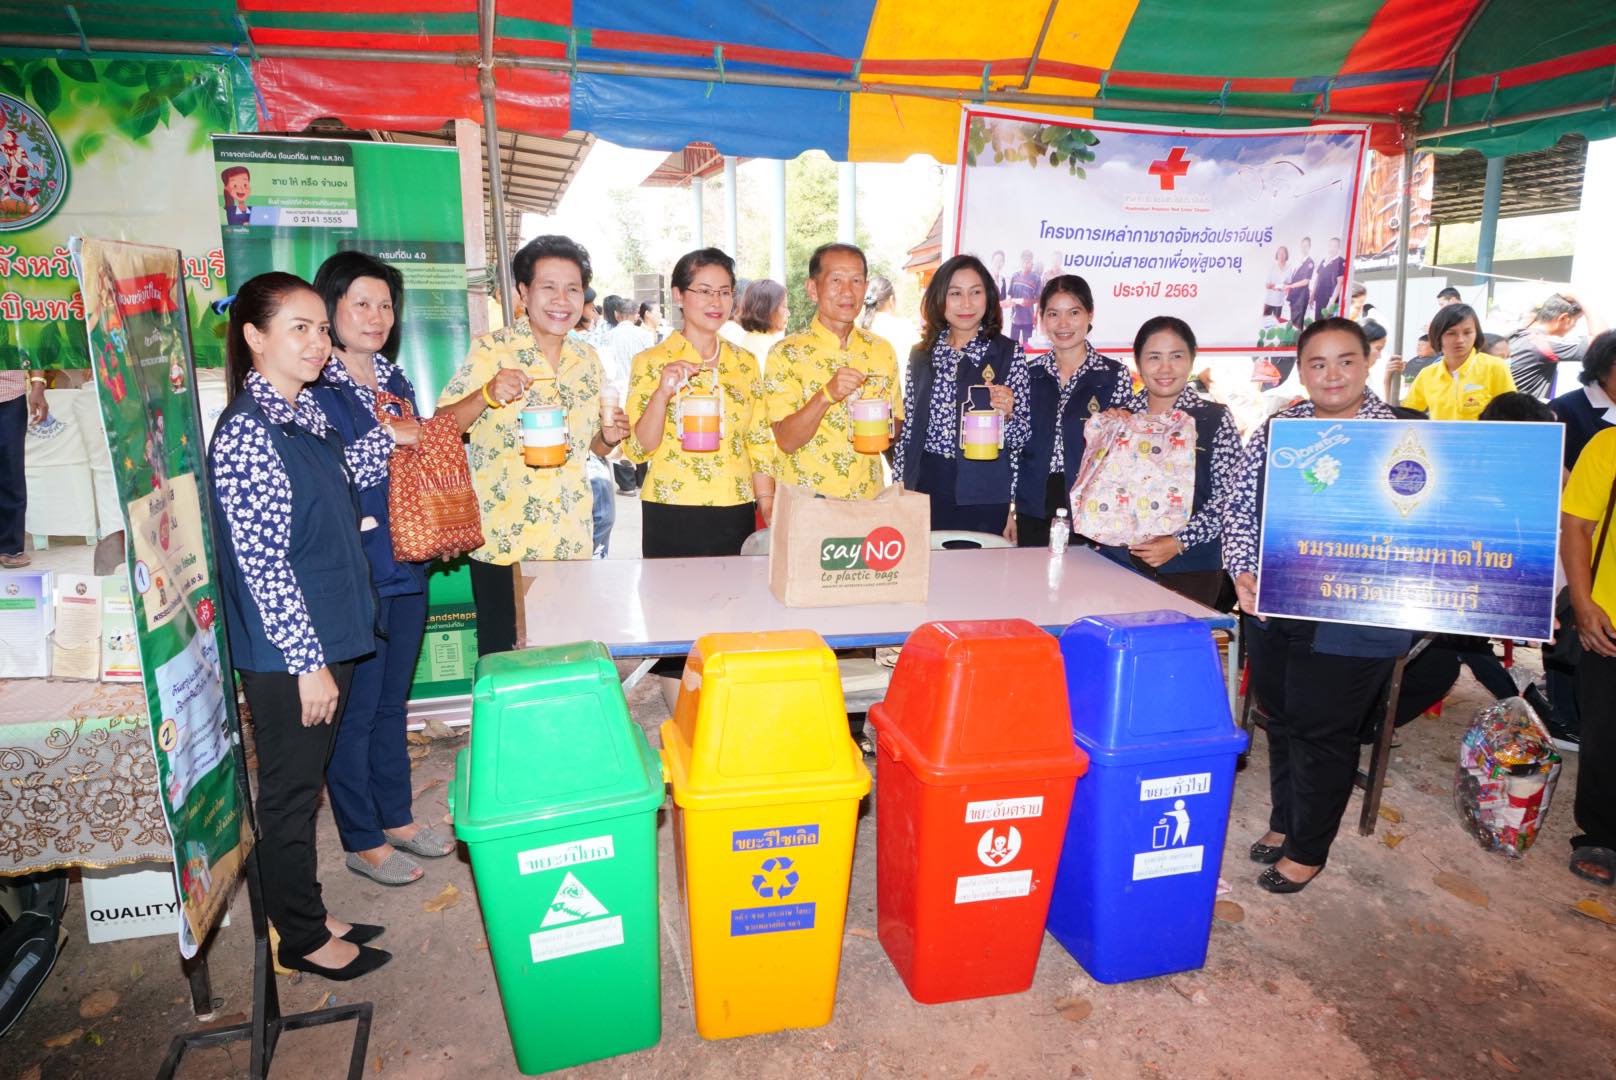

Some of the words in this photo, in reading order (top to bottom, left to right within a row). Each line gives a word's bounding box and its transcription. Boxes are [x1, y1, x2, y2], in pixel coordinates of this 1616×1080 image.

[271, 178, 288, 186] ขาย
[289, 177, 299, 186] ให้
[300, 178, 319, 187] หรือ
[320, 178, 348, 188] จำนอง
[322, 216, 343, 224] 5555
[1040, 220, 1273, 247] โครงการเหล่ากาชาดจังหวัดปราจีนบุรี
[379, 249, 412, 259] กรมที่ดิน
[1063, 250, 1242, 273] มอบแว่นสายตาเพื่อผู้สูงอายุ
[1113, 282, 1160, 298] ประจำปี
[1165, 284, 1198, 298] 2563
[822, 543, 861, 568] say
[865, 540, 902, 561] NO
[1297, 535, 1513, 569] ชมรมแม่บ้านมหาดไทย
[821, 571, 832, 581] to
[836, 570, 870, 583] plastic
[875, 570, 899, 582] bags
[427, 612, 477, 623] andsMaps
[1145, 777, 1207, 798] ขยะทั่วไป
[969, 801, 1040, 820] ขยะอันตราย
[735, 828, 816, 850] ขยะรีไซเคิล
[525, 845, 609, 871] ขยะเปียก
[90, 902, 176, 921] QUALITY
